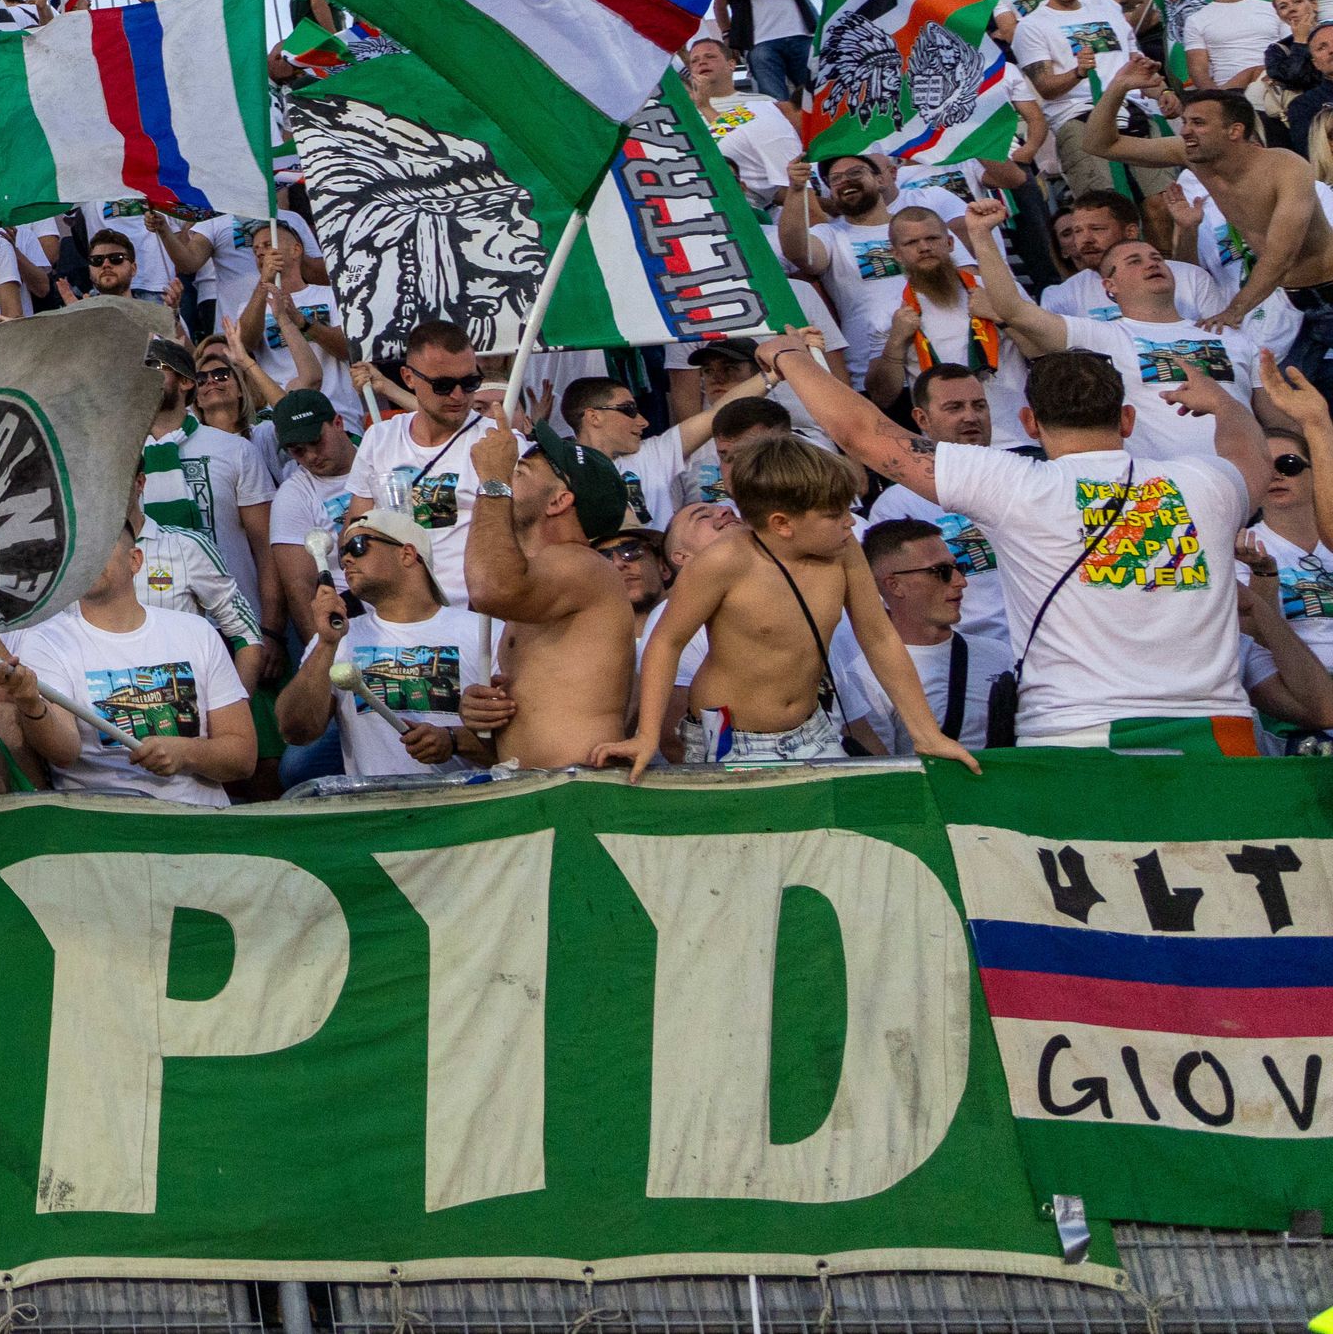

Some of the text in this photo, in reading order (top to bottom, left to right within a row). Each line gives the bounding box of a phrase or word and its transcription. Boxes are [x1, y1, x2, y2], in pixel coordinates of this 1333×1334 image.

[620, 84, 769, 336] ULTRA
[1084, 564, 1207, 586] WIEN
[1038, 844, 1302, 934] ULT
[1037, 1034, 1322, 1131] GIOV
